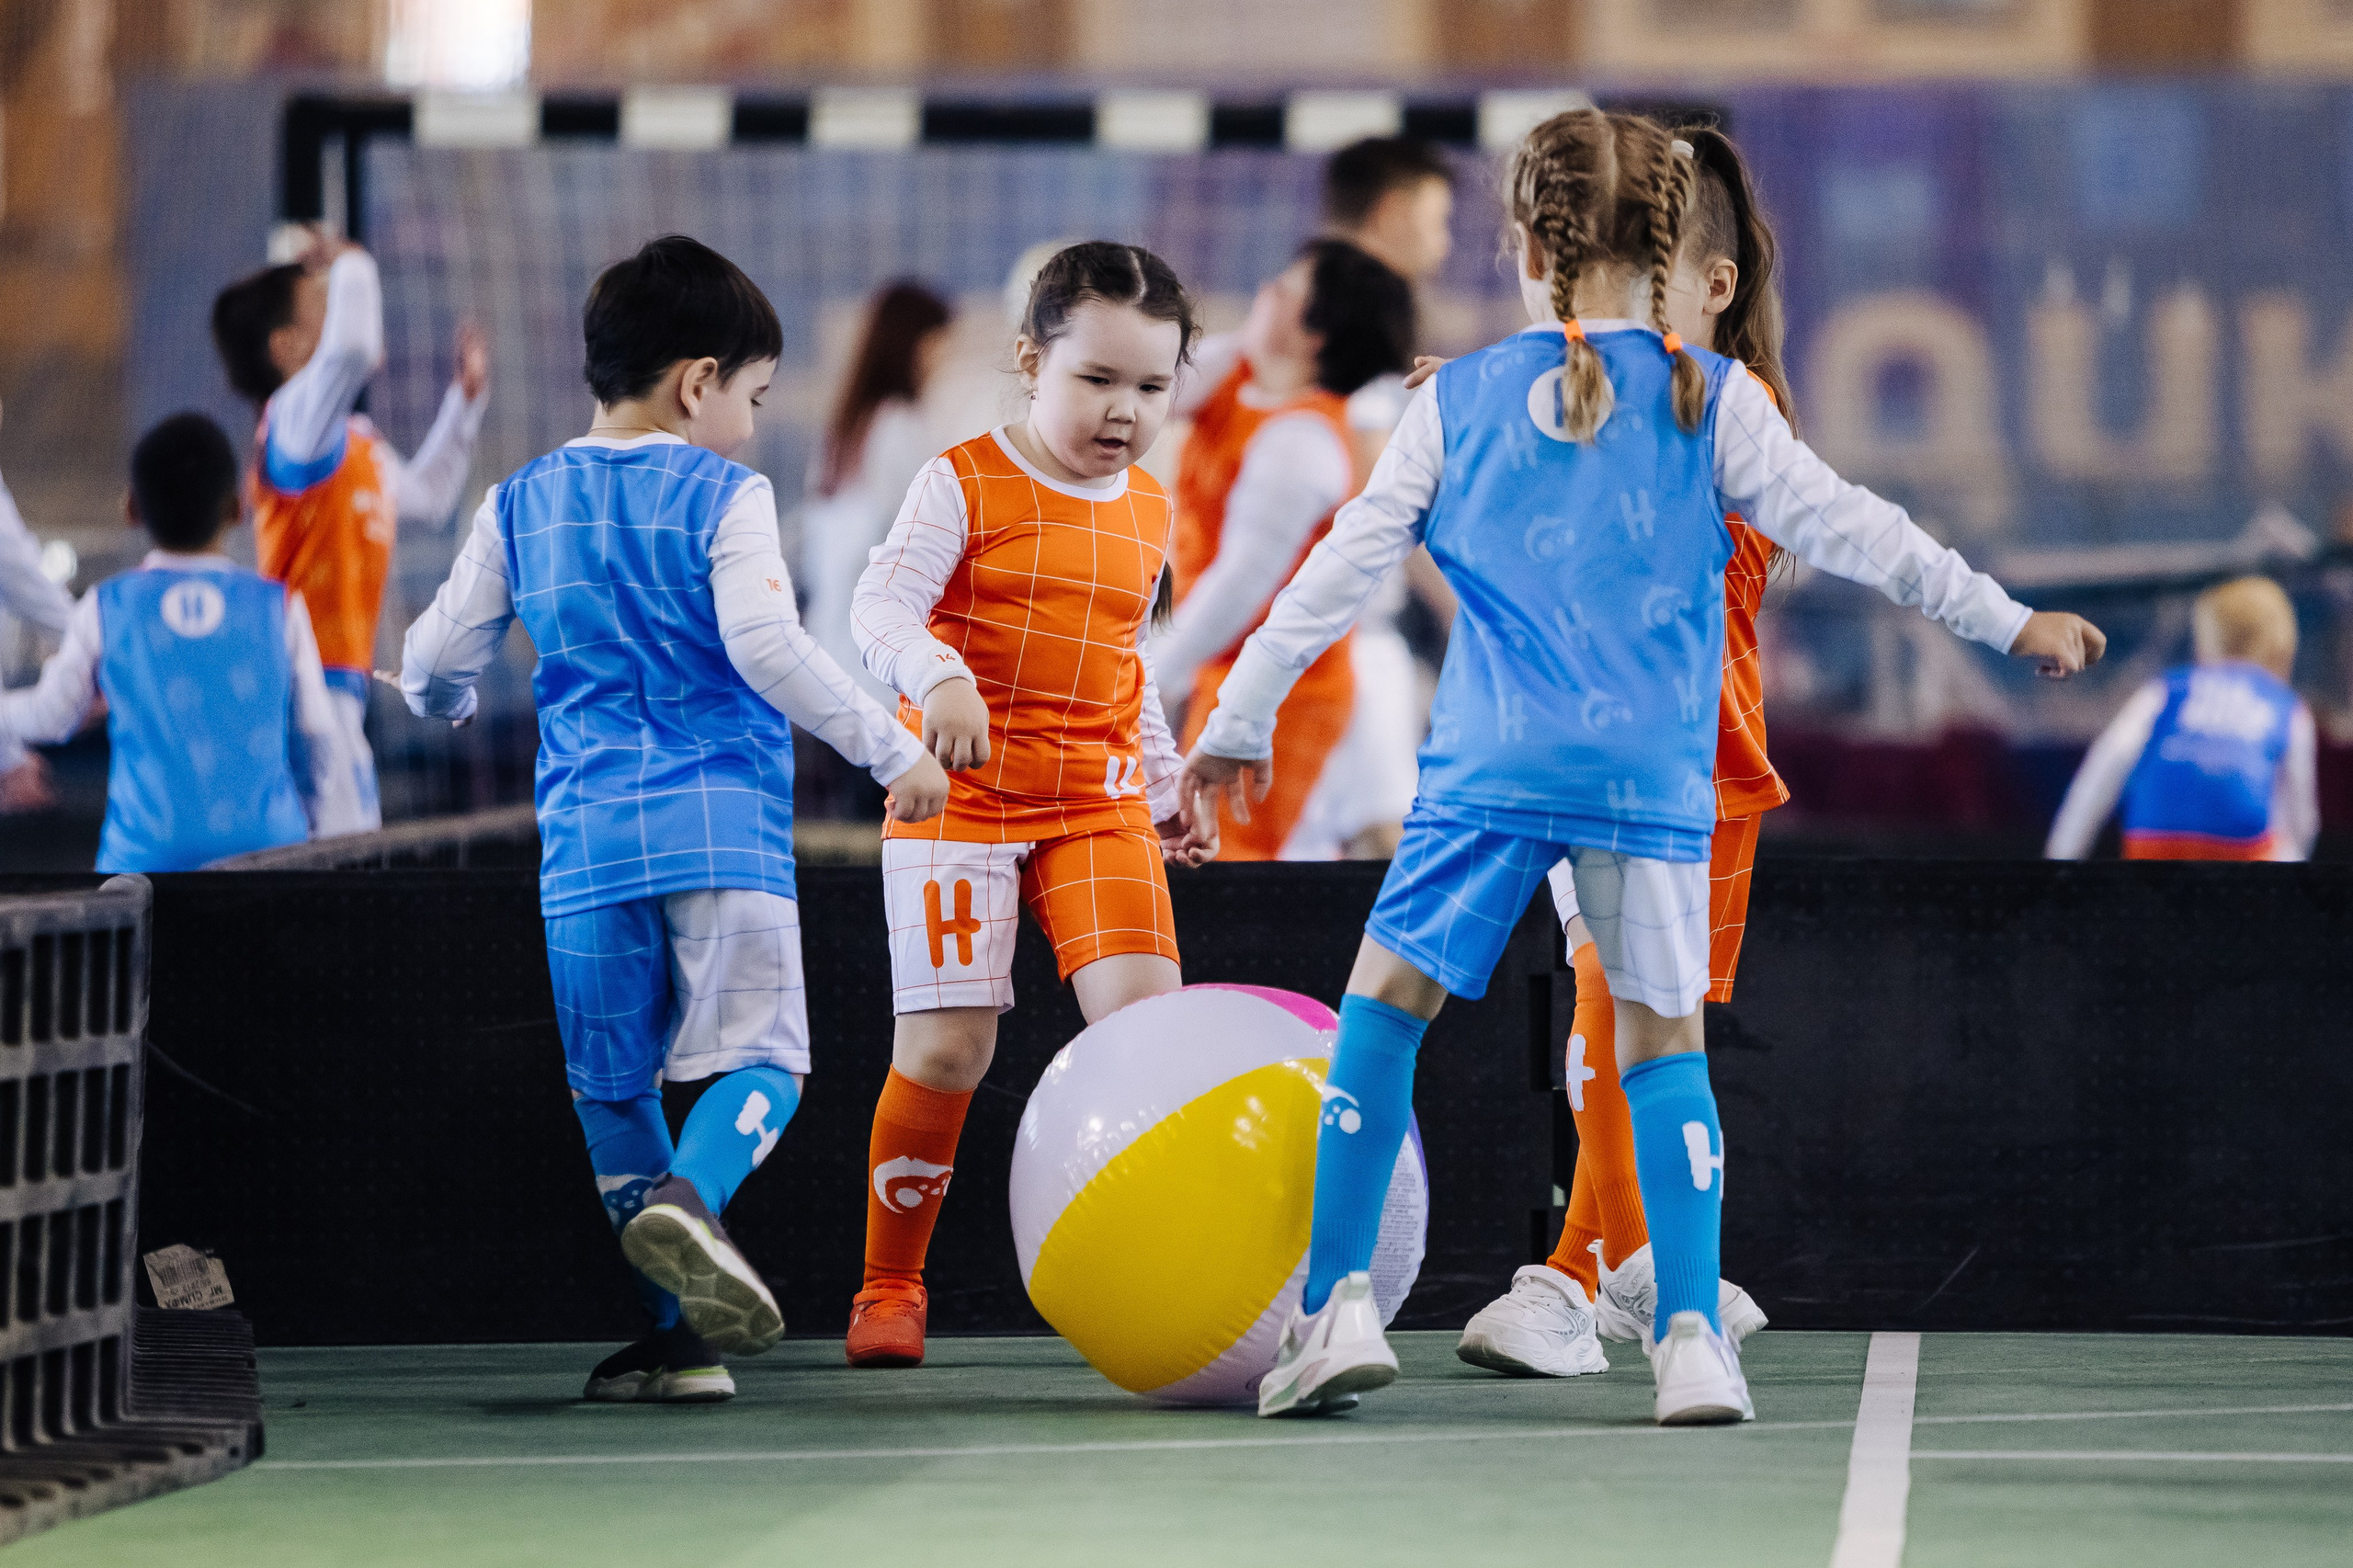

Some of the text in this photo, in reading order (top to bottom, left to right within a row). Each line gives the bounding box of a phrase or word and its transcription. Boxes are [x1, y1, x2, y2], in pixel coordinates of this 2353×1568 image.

[765, 578, 782, 593] 16
[935, 653, 956, 663] 14
[923, 878, 982, 969] H
